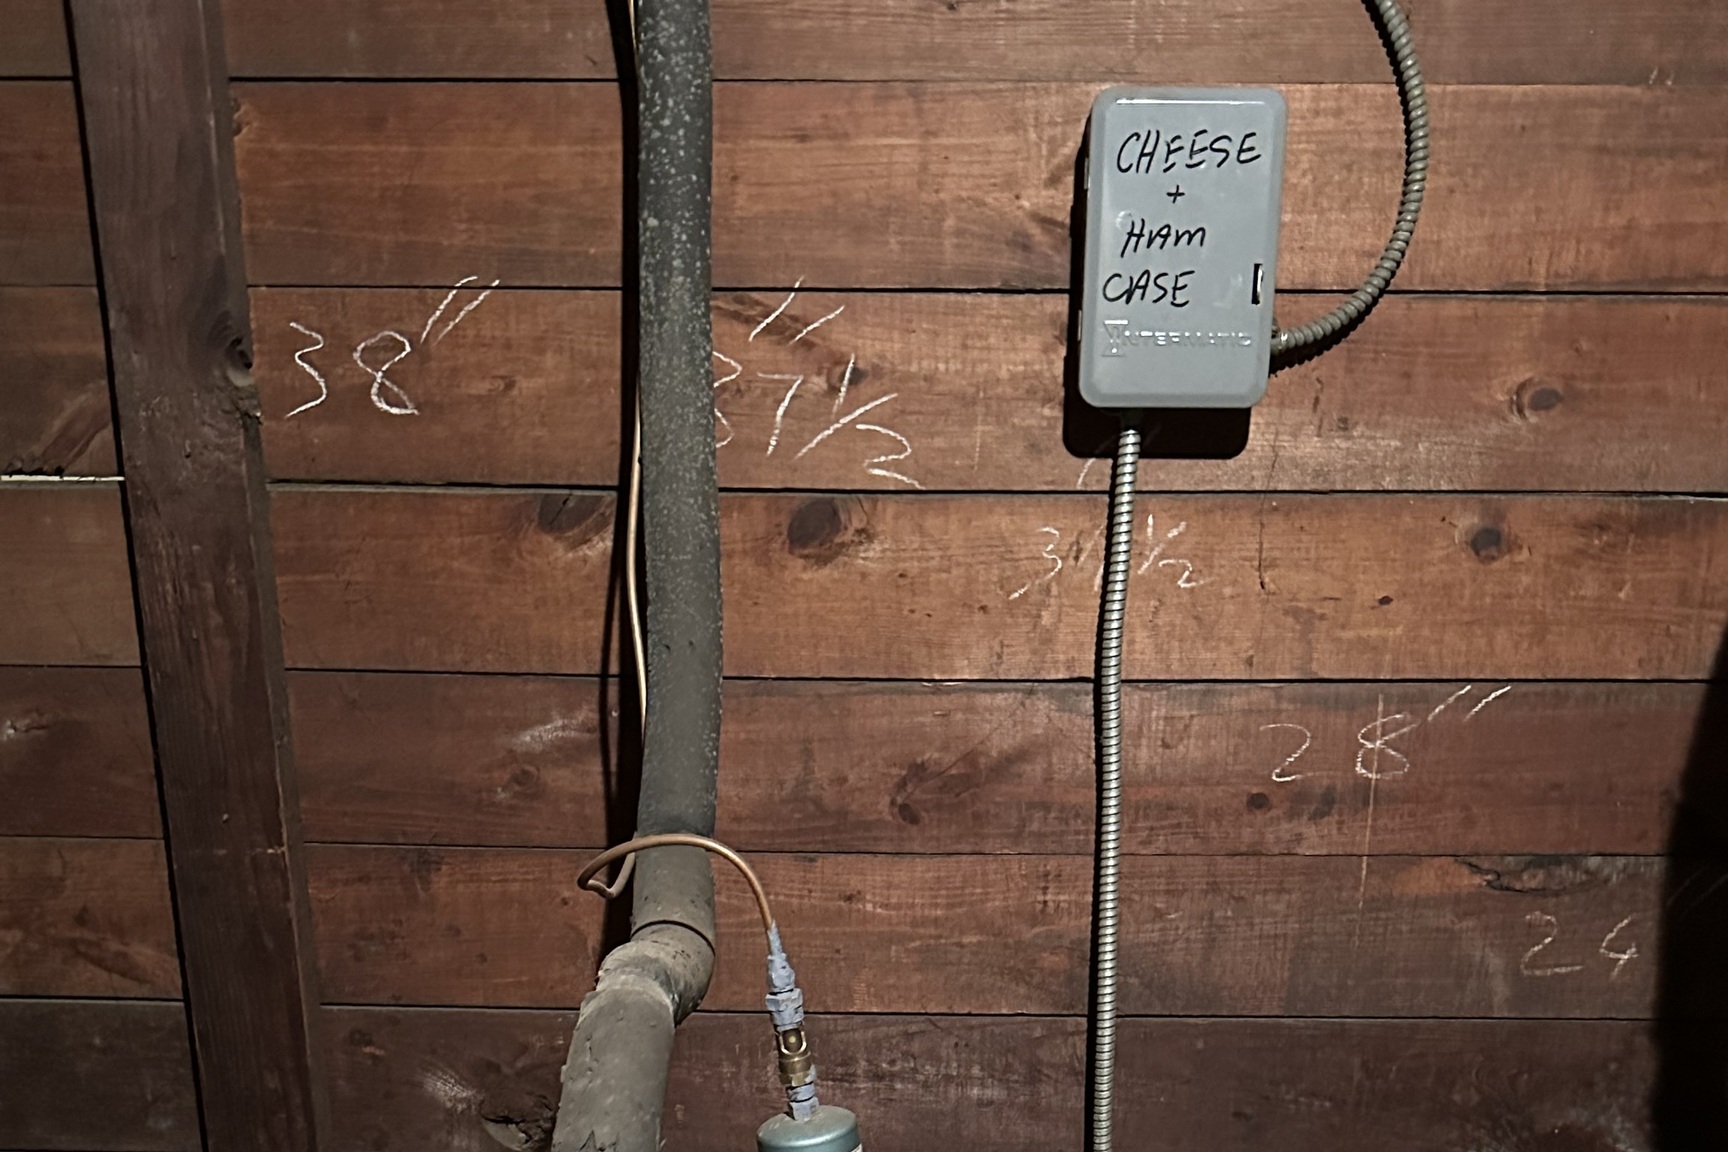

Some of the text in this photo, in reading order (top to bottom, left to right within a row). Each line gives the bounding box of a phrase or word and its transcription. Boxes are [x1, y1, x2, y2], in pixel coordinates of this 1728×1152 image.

[1116, 128, 1262, 175] CHEESE
[1166, 184, 1186, 204] +
[1102, 269, 1196, 308] CASE
